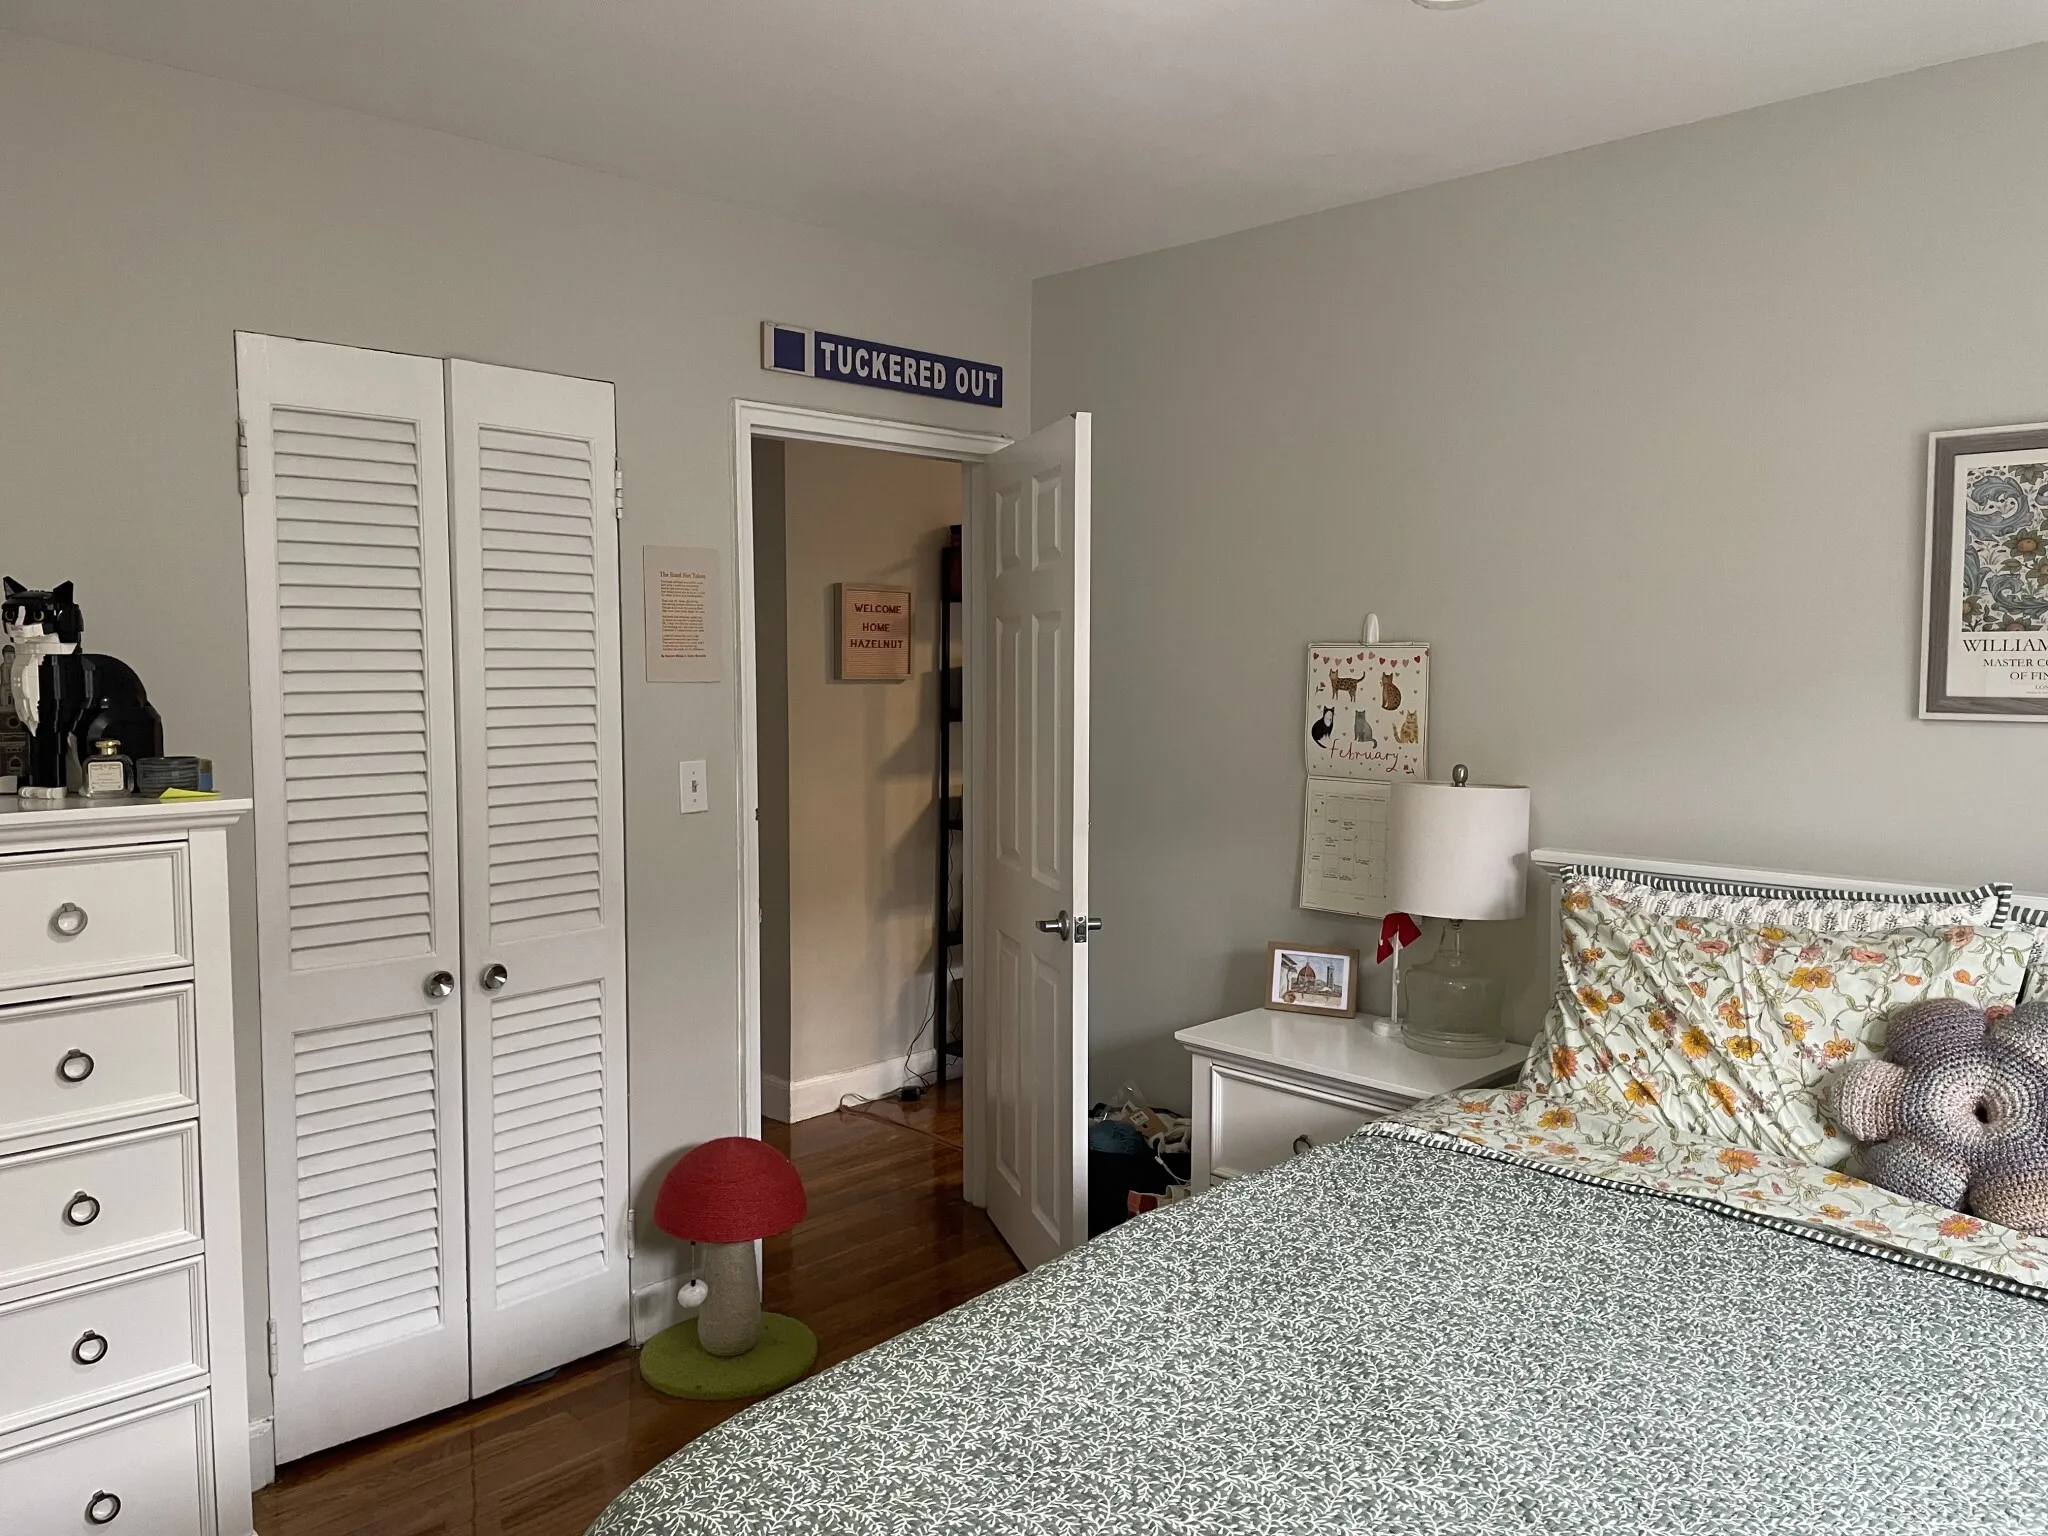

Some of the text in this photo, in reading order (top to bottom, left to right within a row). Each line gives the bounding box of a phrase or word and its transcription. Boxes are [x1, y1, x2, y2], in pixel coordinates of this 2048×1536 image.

[820, 341, 998, 399] TUCKERED OUT
[854, 603, 902, 614] WELCOME
[862, 622, 891, 632] HOME
[850, 638, 904, 649] HAZELNUT
[1983, 658, 2048, 667] MASTER C
[2009, 671, 2028, 680] OF
[1328, 738, 1399, 773] February
